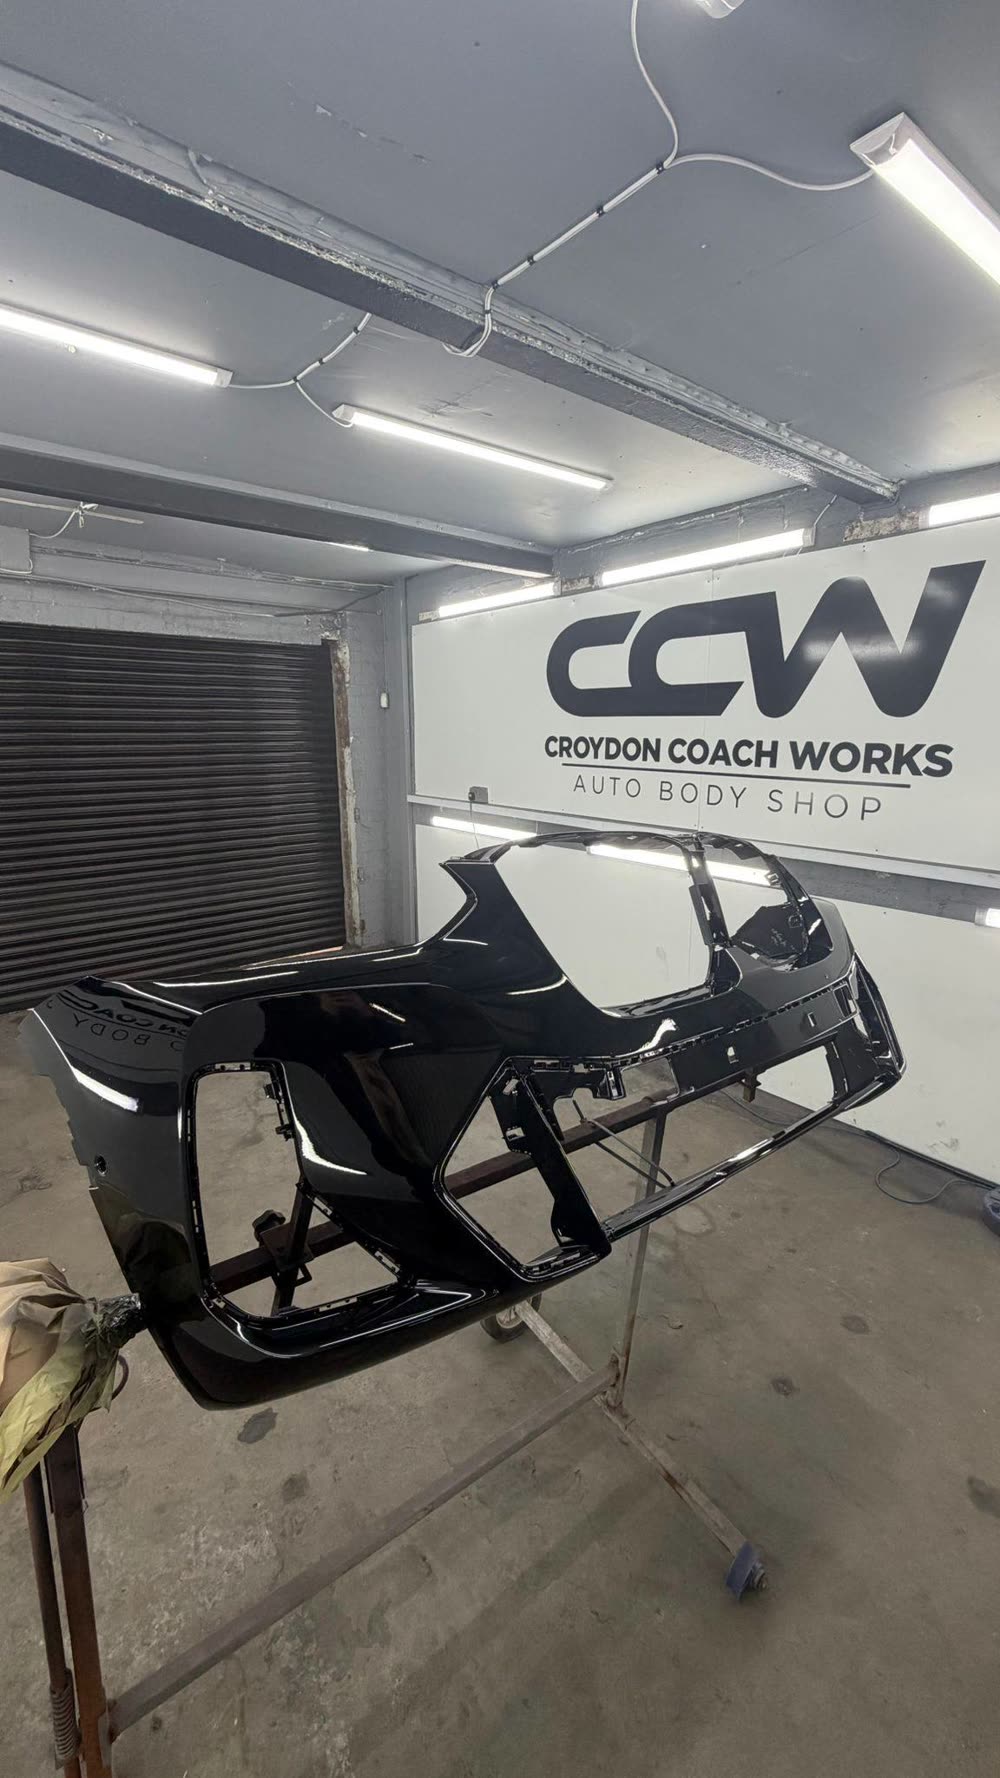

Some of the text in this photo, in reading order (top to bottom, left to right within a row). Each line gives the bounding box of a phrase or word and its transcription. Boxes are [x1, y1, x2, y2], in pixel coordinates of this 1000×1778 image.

[546, 560, 987, 718] CCW
[544, 735, 954, 778] CROYDON COACH WORKS
[573, 774, 882, 821] AUTO BODY SHOP
